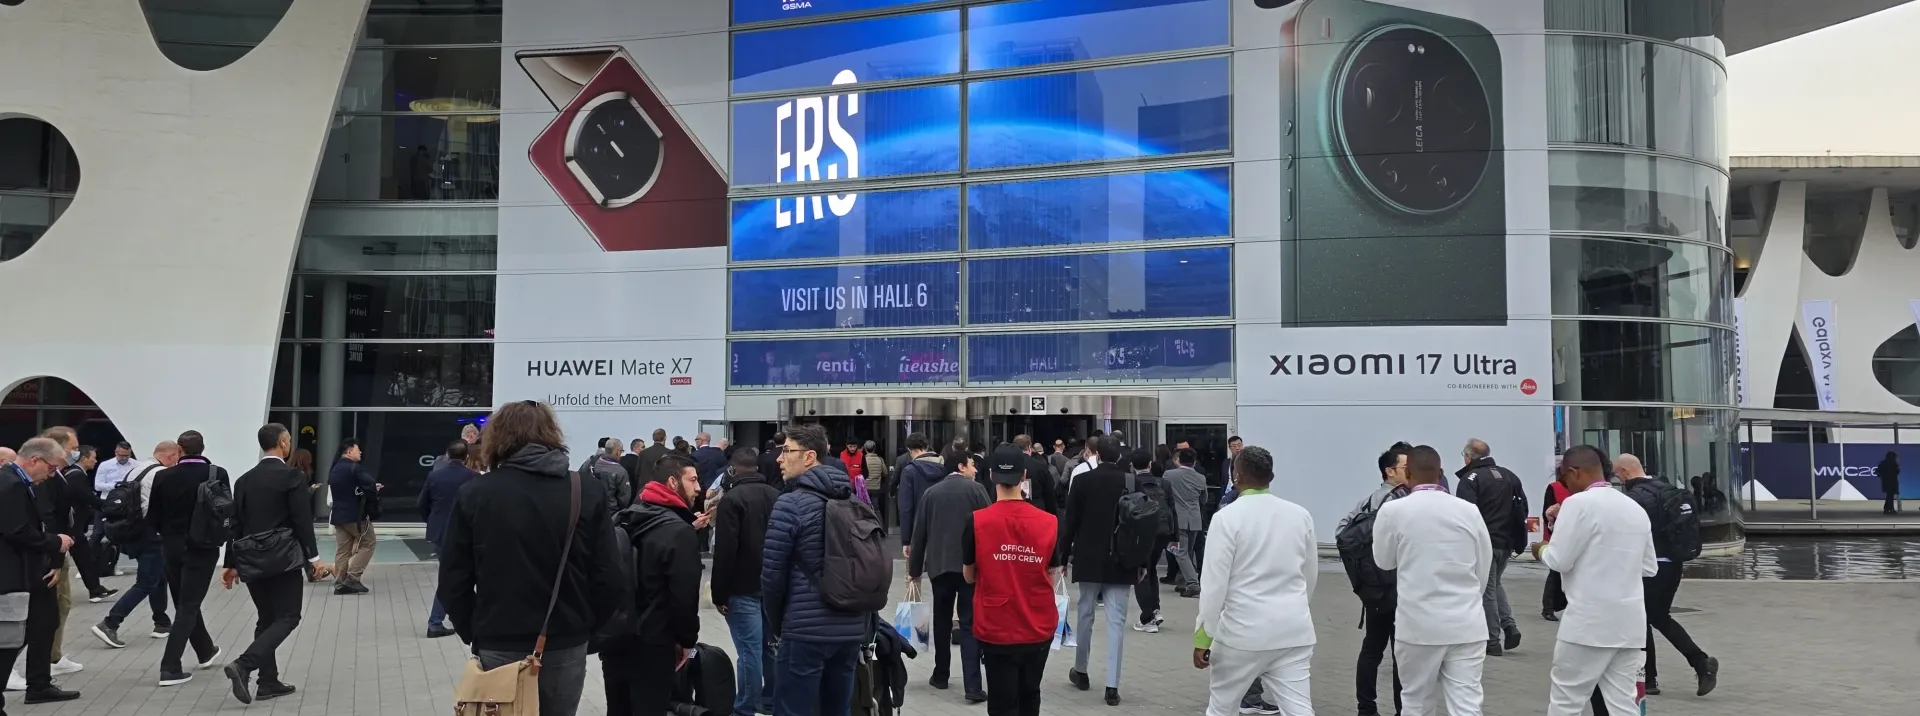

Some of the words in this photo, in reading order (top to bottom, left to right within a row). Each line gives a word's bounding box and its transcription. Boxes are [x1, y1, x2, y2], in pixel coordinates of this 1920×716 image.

[782, 2, 812, 10] GSMA
[776, 69, 859, 229] ERS
[781, 287, 820, 312] VISIT
[824, 286, 846, 310] US
[851, 285, 868, 309] IN
[874, 284, 913, 308] HALL
[917, 283, 928, 308] 6
[527, 359, 613, 377] HUAWEI
[621, 359, 665, 376] Mate
[671, 357, 693, 375] X7
[1416, 354, 1442, 375] 17
[1453, 353, 1517, 375] Ultra
[548, 393, 590, 407] Unfold
[594, 393, 614, 406] the
[619, 393, 672, 405] Moment
[1000, 544, 1036, 554] OFFICIAL
[993, 553, 1017, 561] VIDEO
[1018, 554, 1044, 564] CREW
